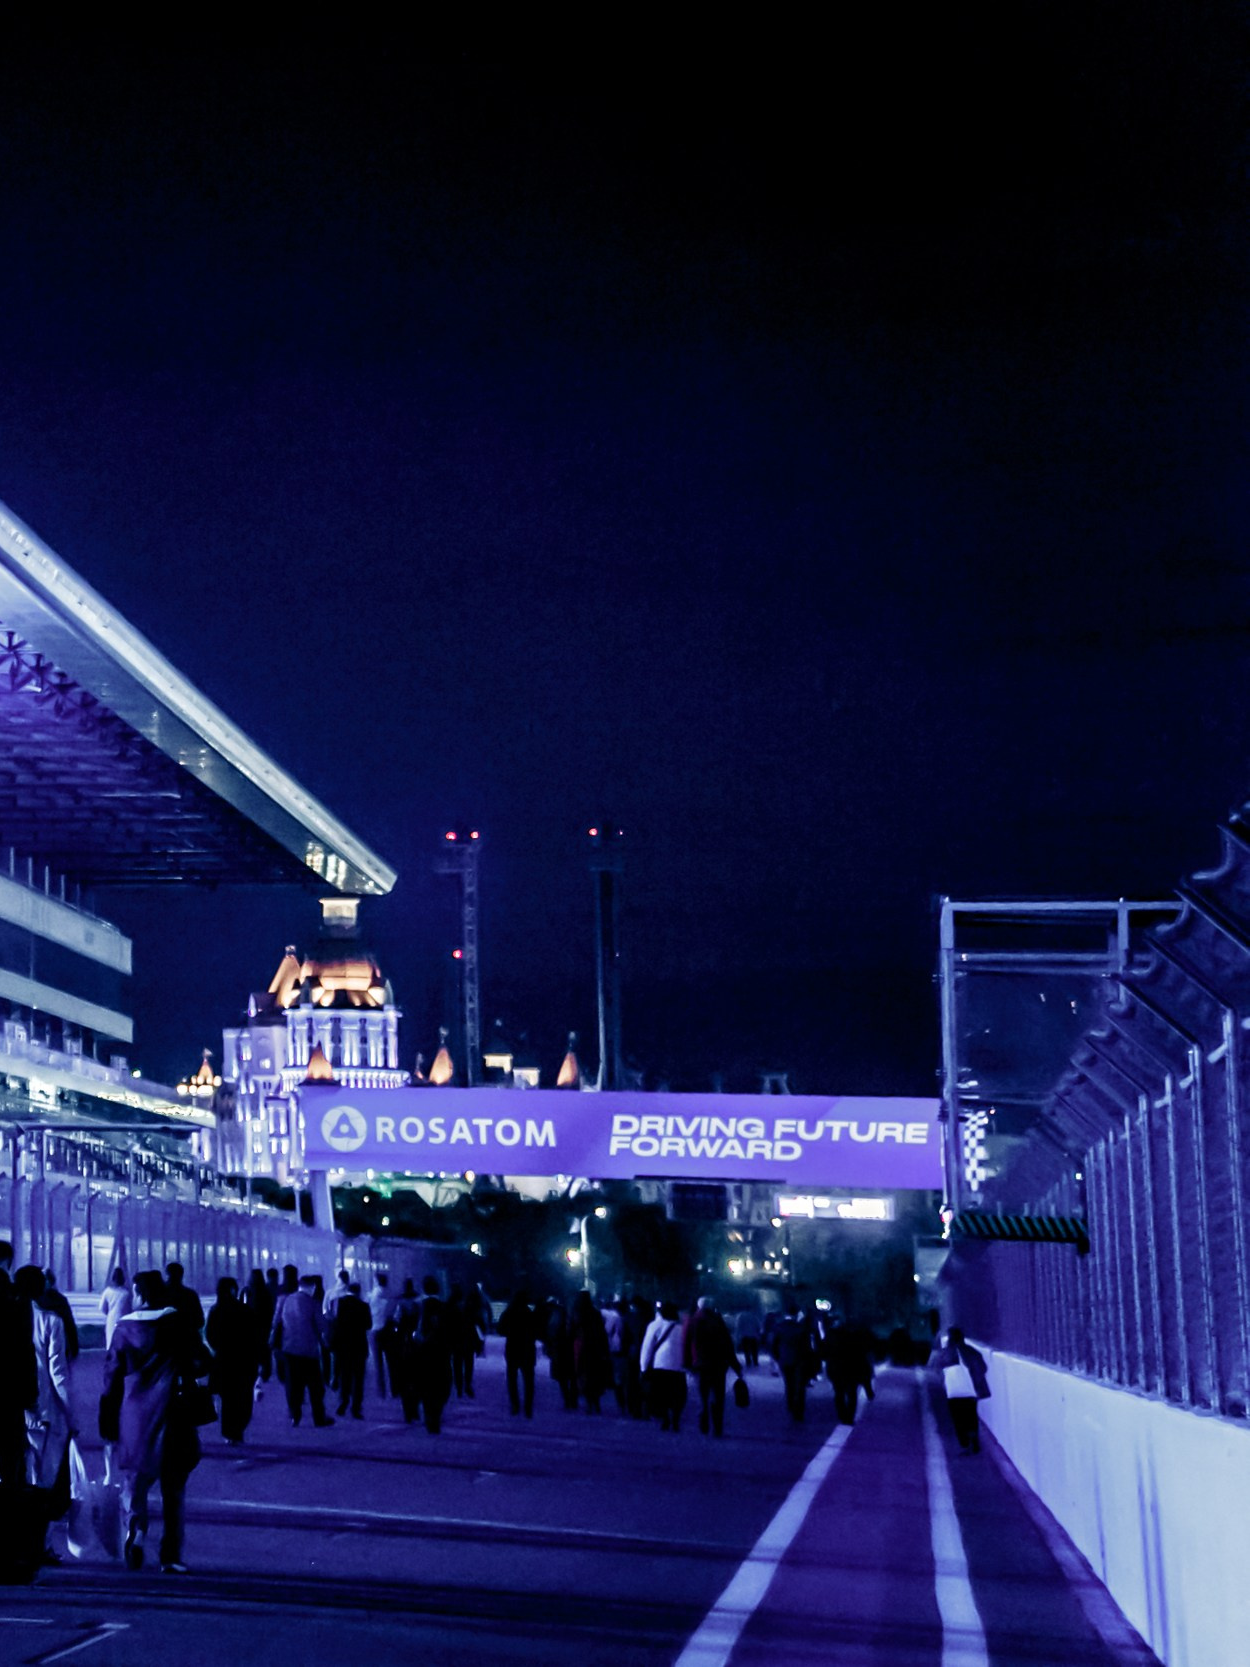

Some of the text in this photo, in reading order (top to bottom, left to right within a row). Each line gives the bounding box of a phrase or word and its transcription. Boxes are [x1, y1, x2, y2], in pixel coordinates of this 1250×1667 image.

[375, 1116, 556, 1148] ROSATOM
[612, 1114, 929, 1144] DRIVING FUTURE
[609, 1136, 803, 1161] FORWARD
